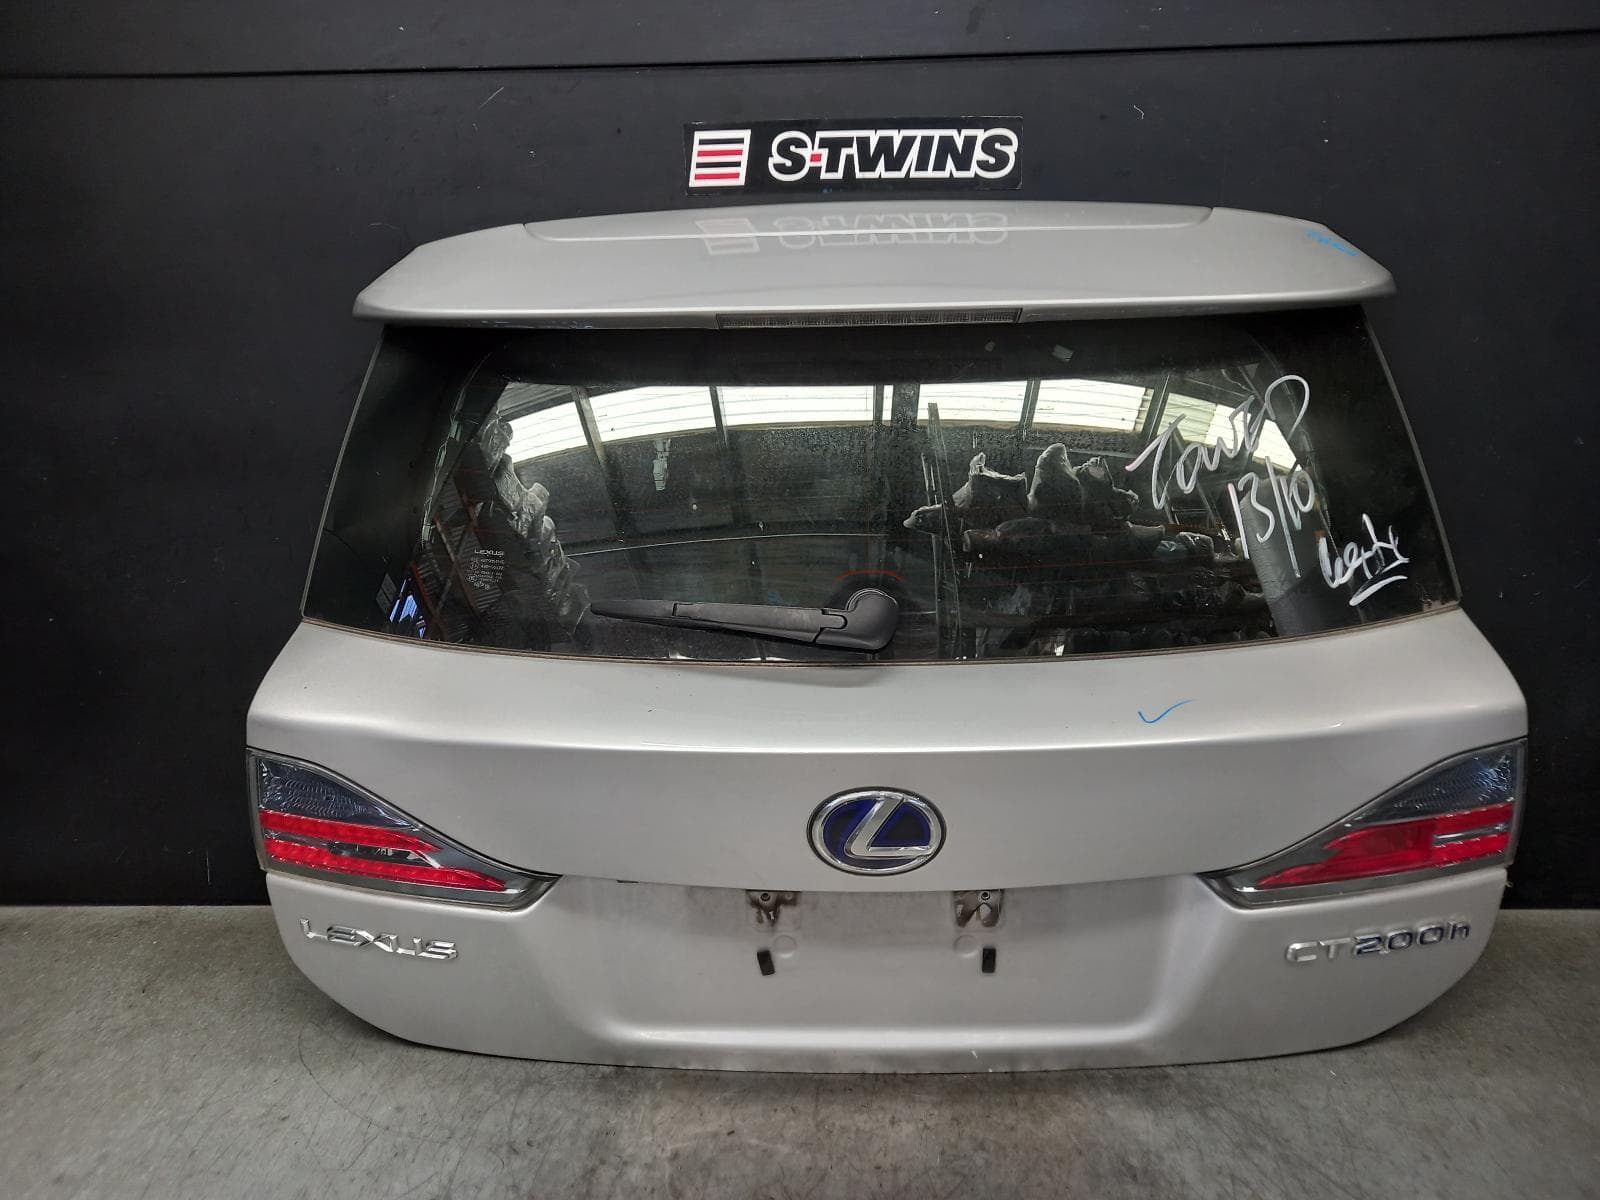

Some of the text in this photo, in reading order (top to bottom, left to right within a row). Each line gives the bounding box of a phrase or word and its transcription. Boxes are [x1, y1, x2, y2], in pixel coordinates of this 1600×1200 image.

[768, 128, 1019, 182] S-TWINS
[300, 919, 458, 960] LEXUS
[1286, 919, 1471, 963] CT200h
